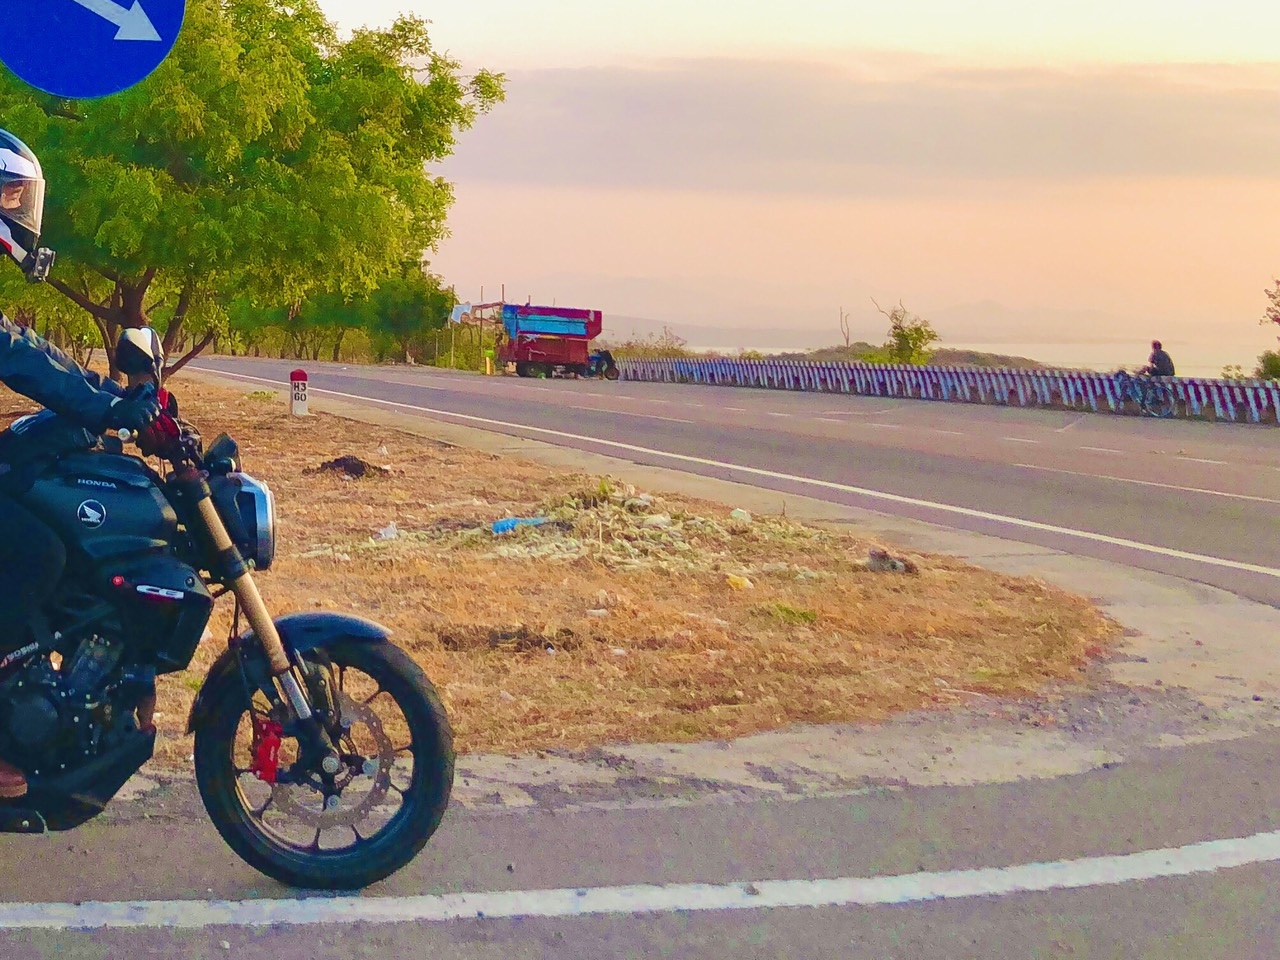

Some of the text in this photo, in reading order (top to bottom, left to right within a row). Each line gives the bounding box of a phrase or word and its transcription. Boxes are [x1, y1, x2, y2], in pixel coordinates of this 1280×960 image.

[293, 382, 307, 392] H3
[294, 392, 307, 402] 60
[77, 478, 118, 489] HONDA
